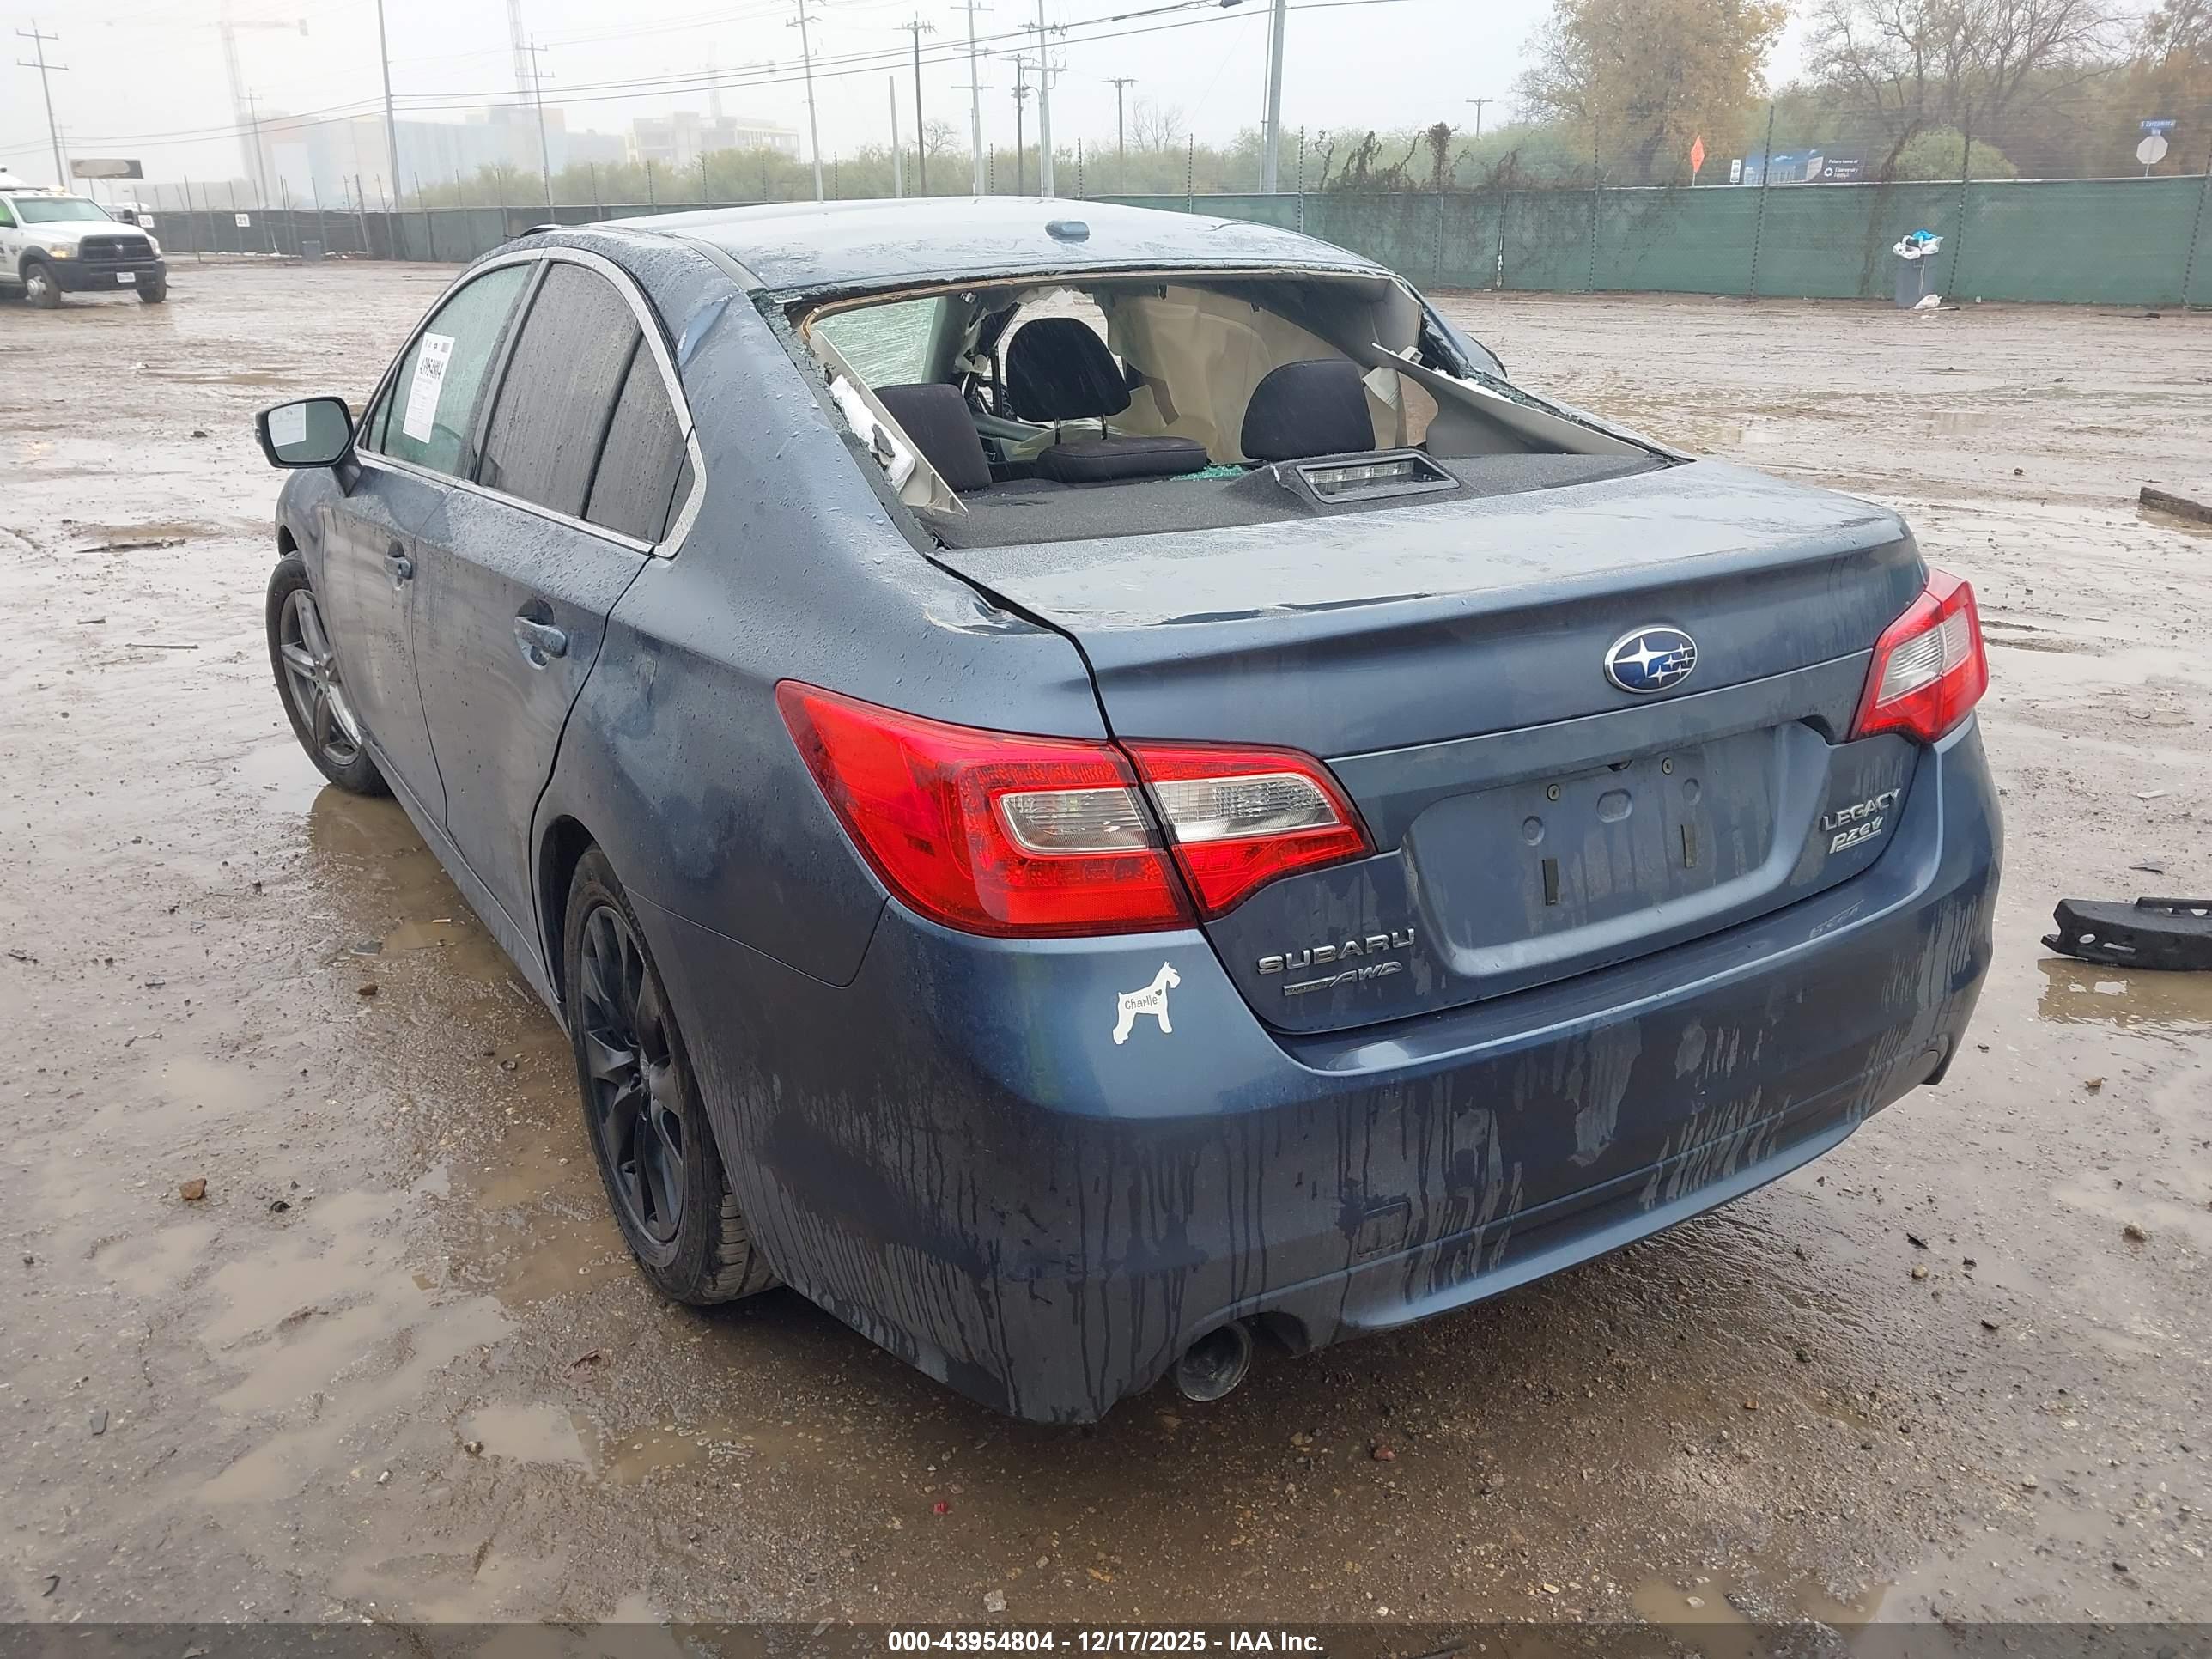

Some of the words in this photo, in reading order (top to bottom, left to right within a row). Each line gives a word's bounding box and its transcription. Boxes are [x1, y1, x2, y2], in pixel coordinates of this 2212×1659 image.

[236, 216, 248, 226] 21
[1820, 787, 1901, 832] LEGACY
[1257, 927, 1415, 975] SUBARU
[1329, 960, 1403, 988] AWD
